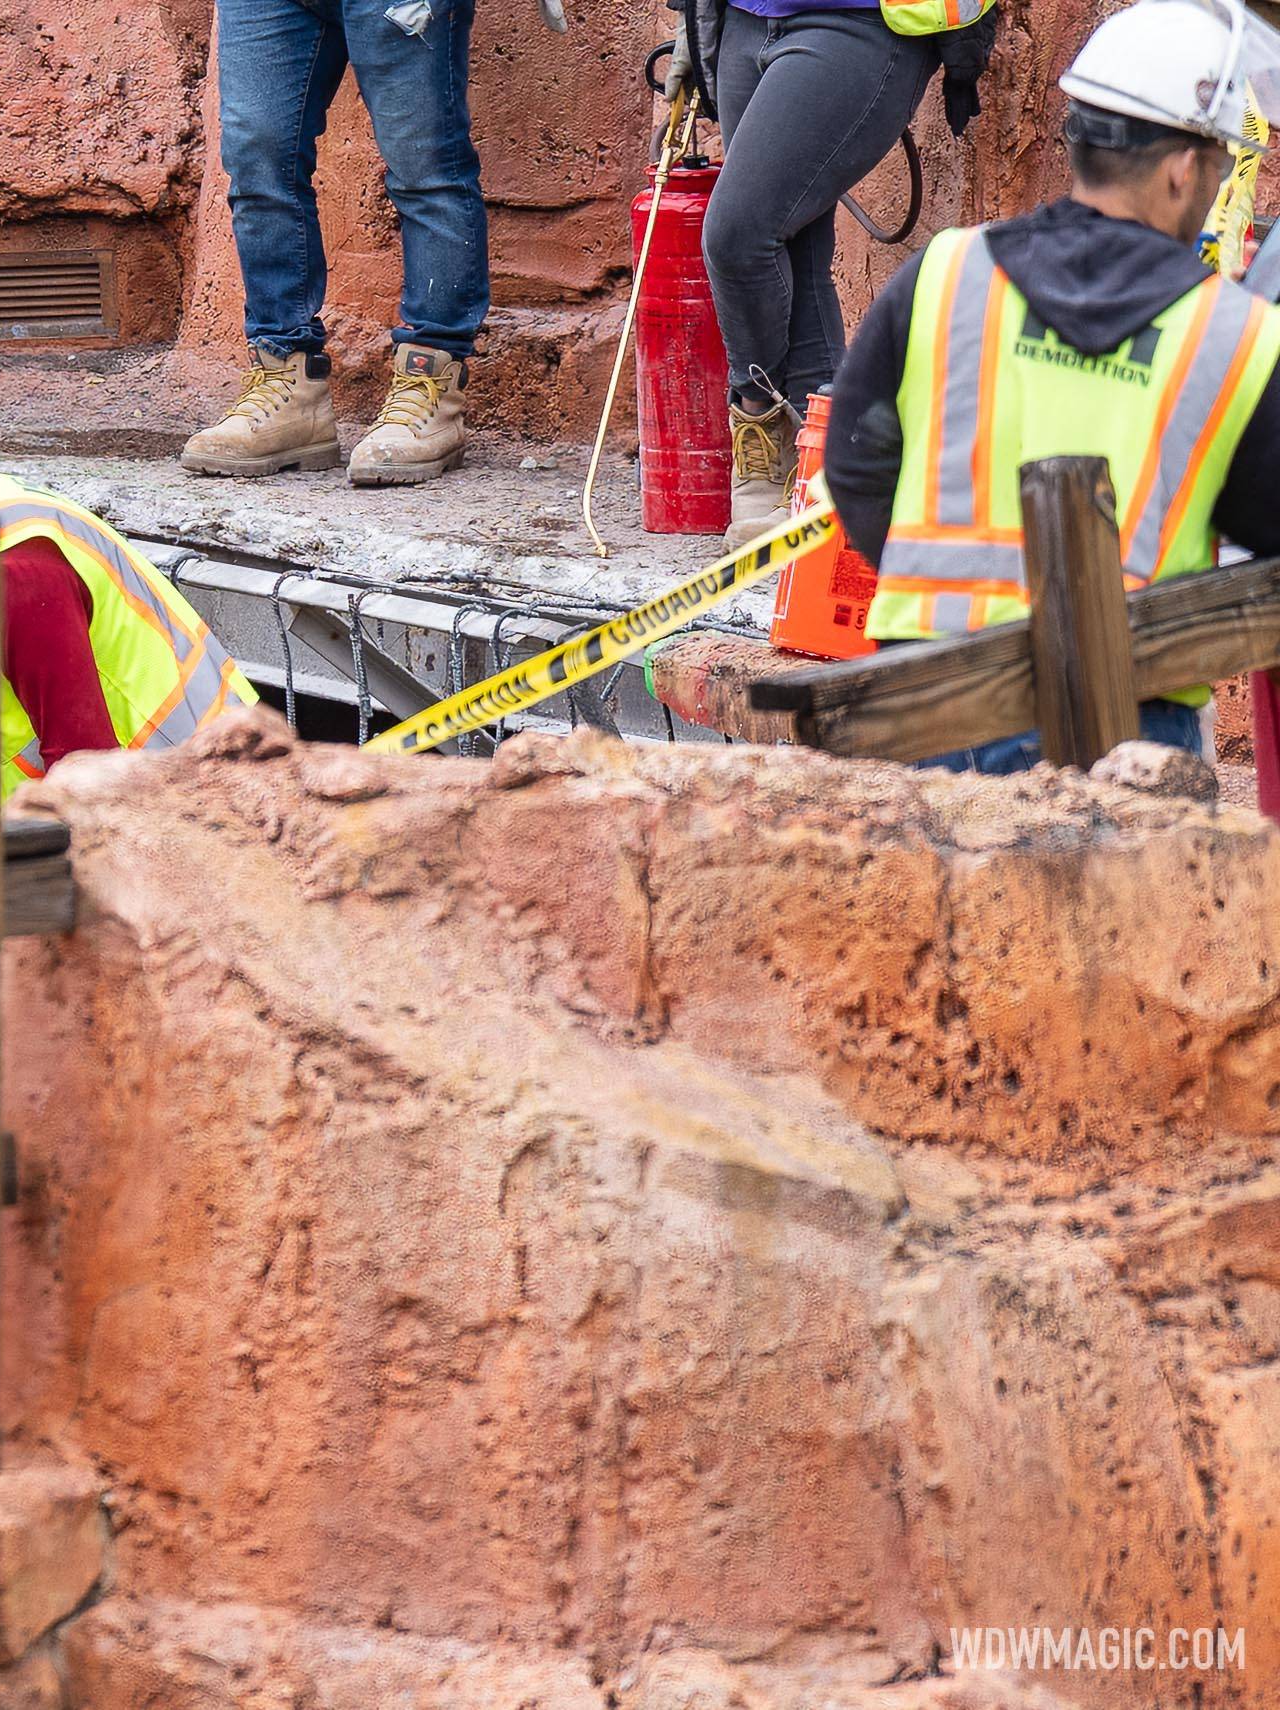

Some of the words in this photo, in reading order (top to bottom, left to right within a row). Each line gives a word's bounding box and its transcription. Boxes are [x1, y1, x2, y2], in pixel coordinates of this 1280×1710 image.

[1014, 341, 1152, 387] DEMOLITION
[426, 671, 539, 742] CAUTION
[609, 572, 720, 646] CUIDADO
